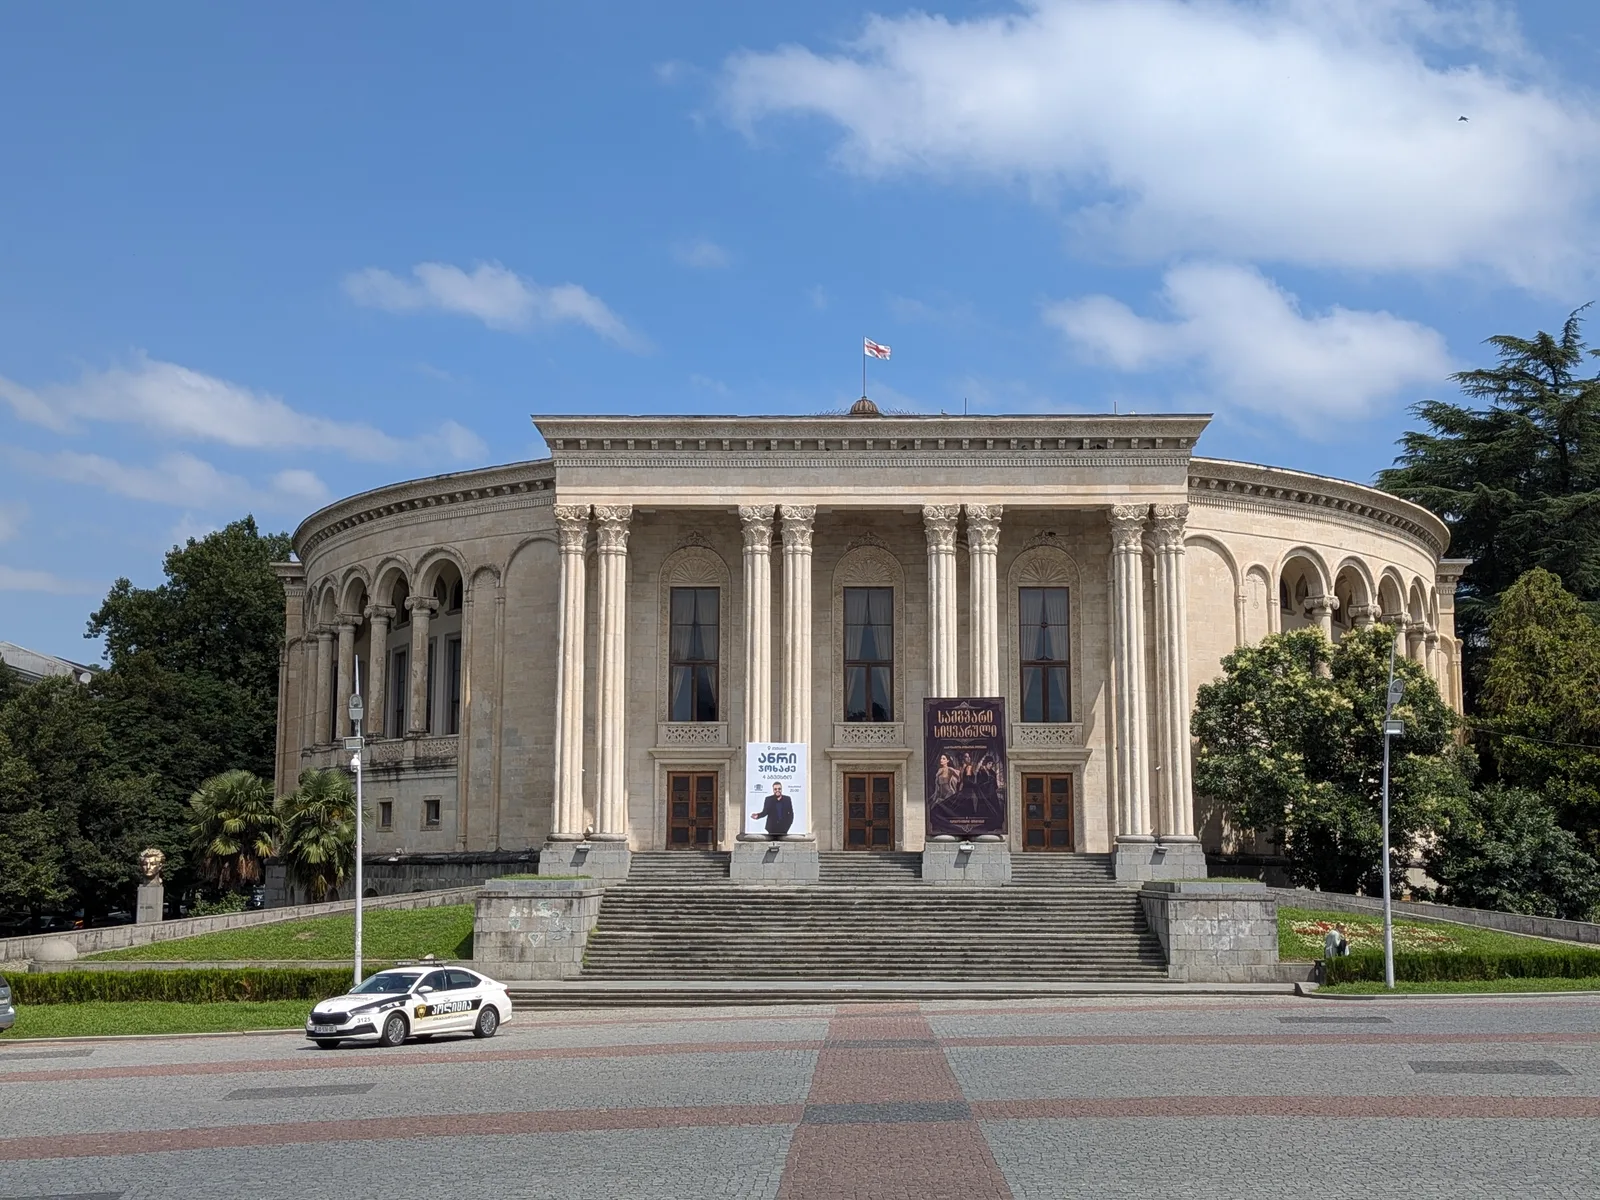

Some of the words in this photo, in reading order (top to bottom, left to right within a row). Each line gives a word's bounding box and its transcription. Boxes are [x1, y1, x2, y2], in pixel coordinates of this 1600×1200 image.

[938, 710, 993, 724] სამგვარი
[934, 724, 997, 738] სიყვარული
[758, 752, 796, 764] ანრი
[758, 764, 796, 772] ჯოხაძე
[432, 1000, 472, 1015] პოლიცია
